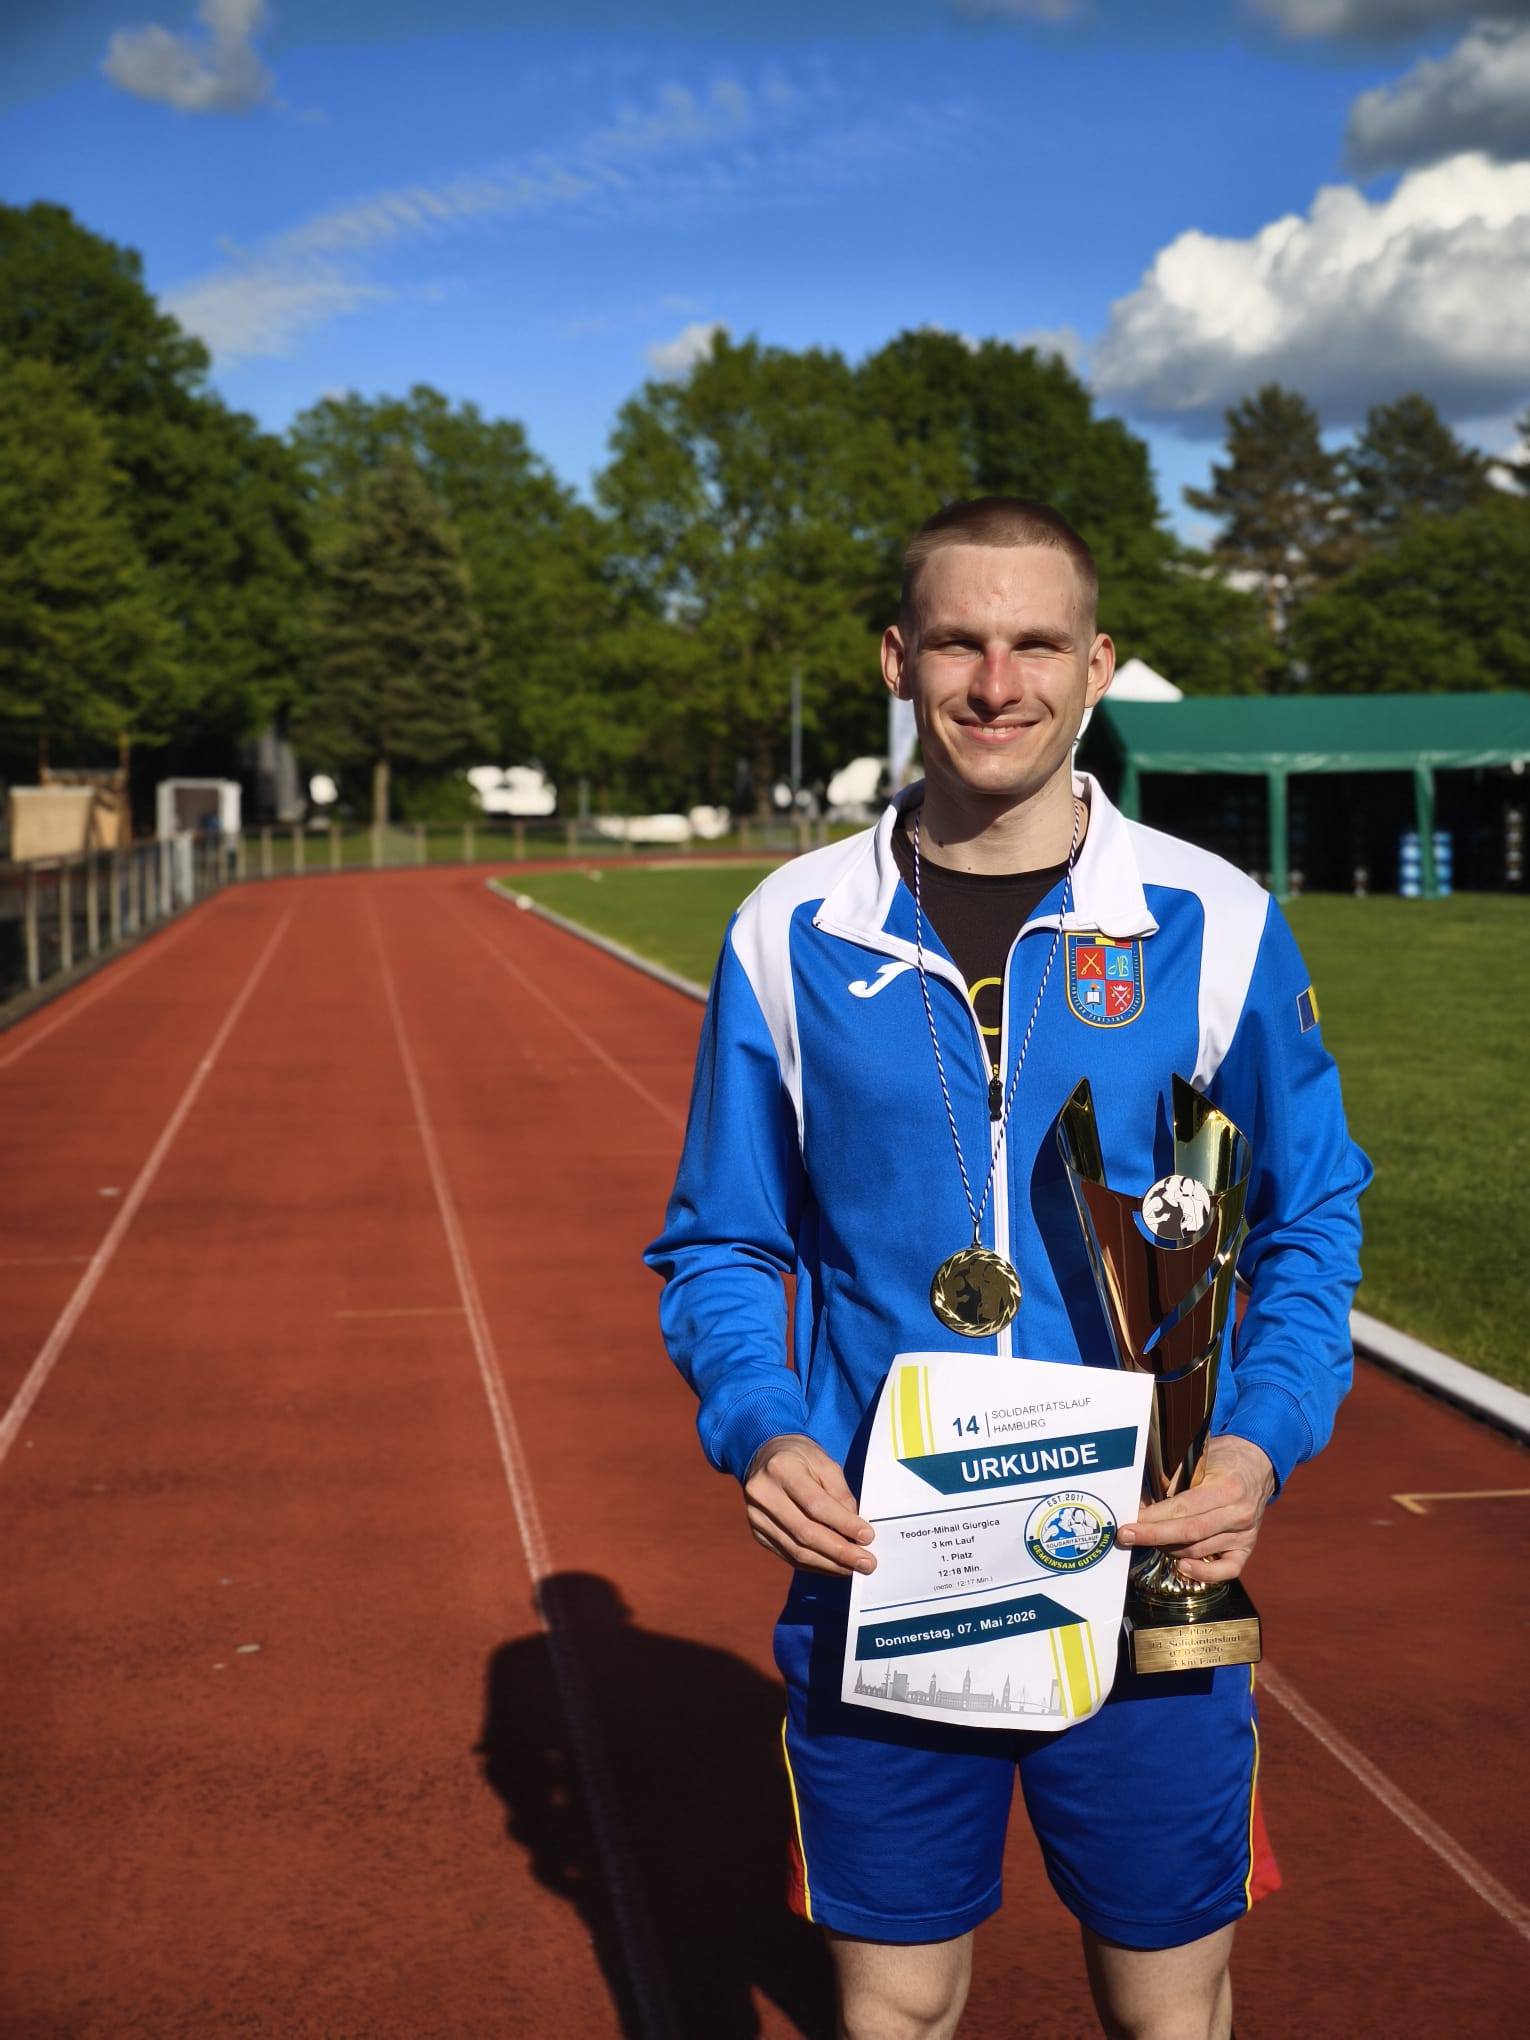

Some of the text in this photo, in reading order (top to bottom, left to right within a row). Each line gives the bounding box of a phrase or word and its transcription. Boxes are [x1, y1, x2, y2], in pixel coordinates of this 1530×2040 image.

[991, 1397, 1092, 1419] SOLIDARITÄTSLAUF
[953, 1415, 980, 1437] 14
[993, 1418, 1046, 1433] HAMBURG
[961, 1443, 1099, 1483] URKUNDE
[900, 1519, 1000, 1539] Teodor-Mihail Giurgica
[931, 1536, 975, 1549] 3 km Lauf
[951, 1552, 973, 1561] Platz
[1033, 1544, 1076, 1569] GEMEINSAM
[1078, 1549, 1102, 1567] GUTES
[938, 1565, 983, 1577] 12:18 Min.
[957, 1578, 974, 1587] 12:17
[875, 1609, 1037, 1648] Donnerstag, 07. Mai 2026
